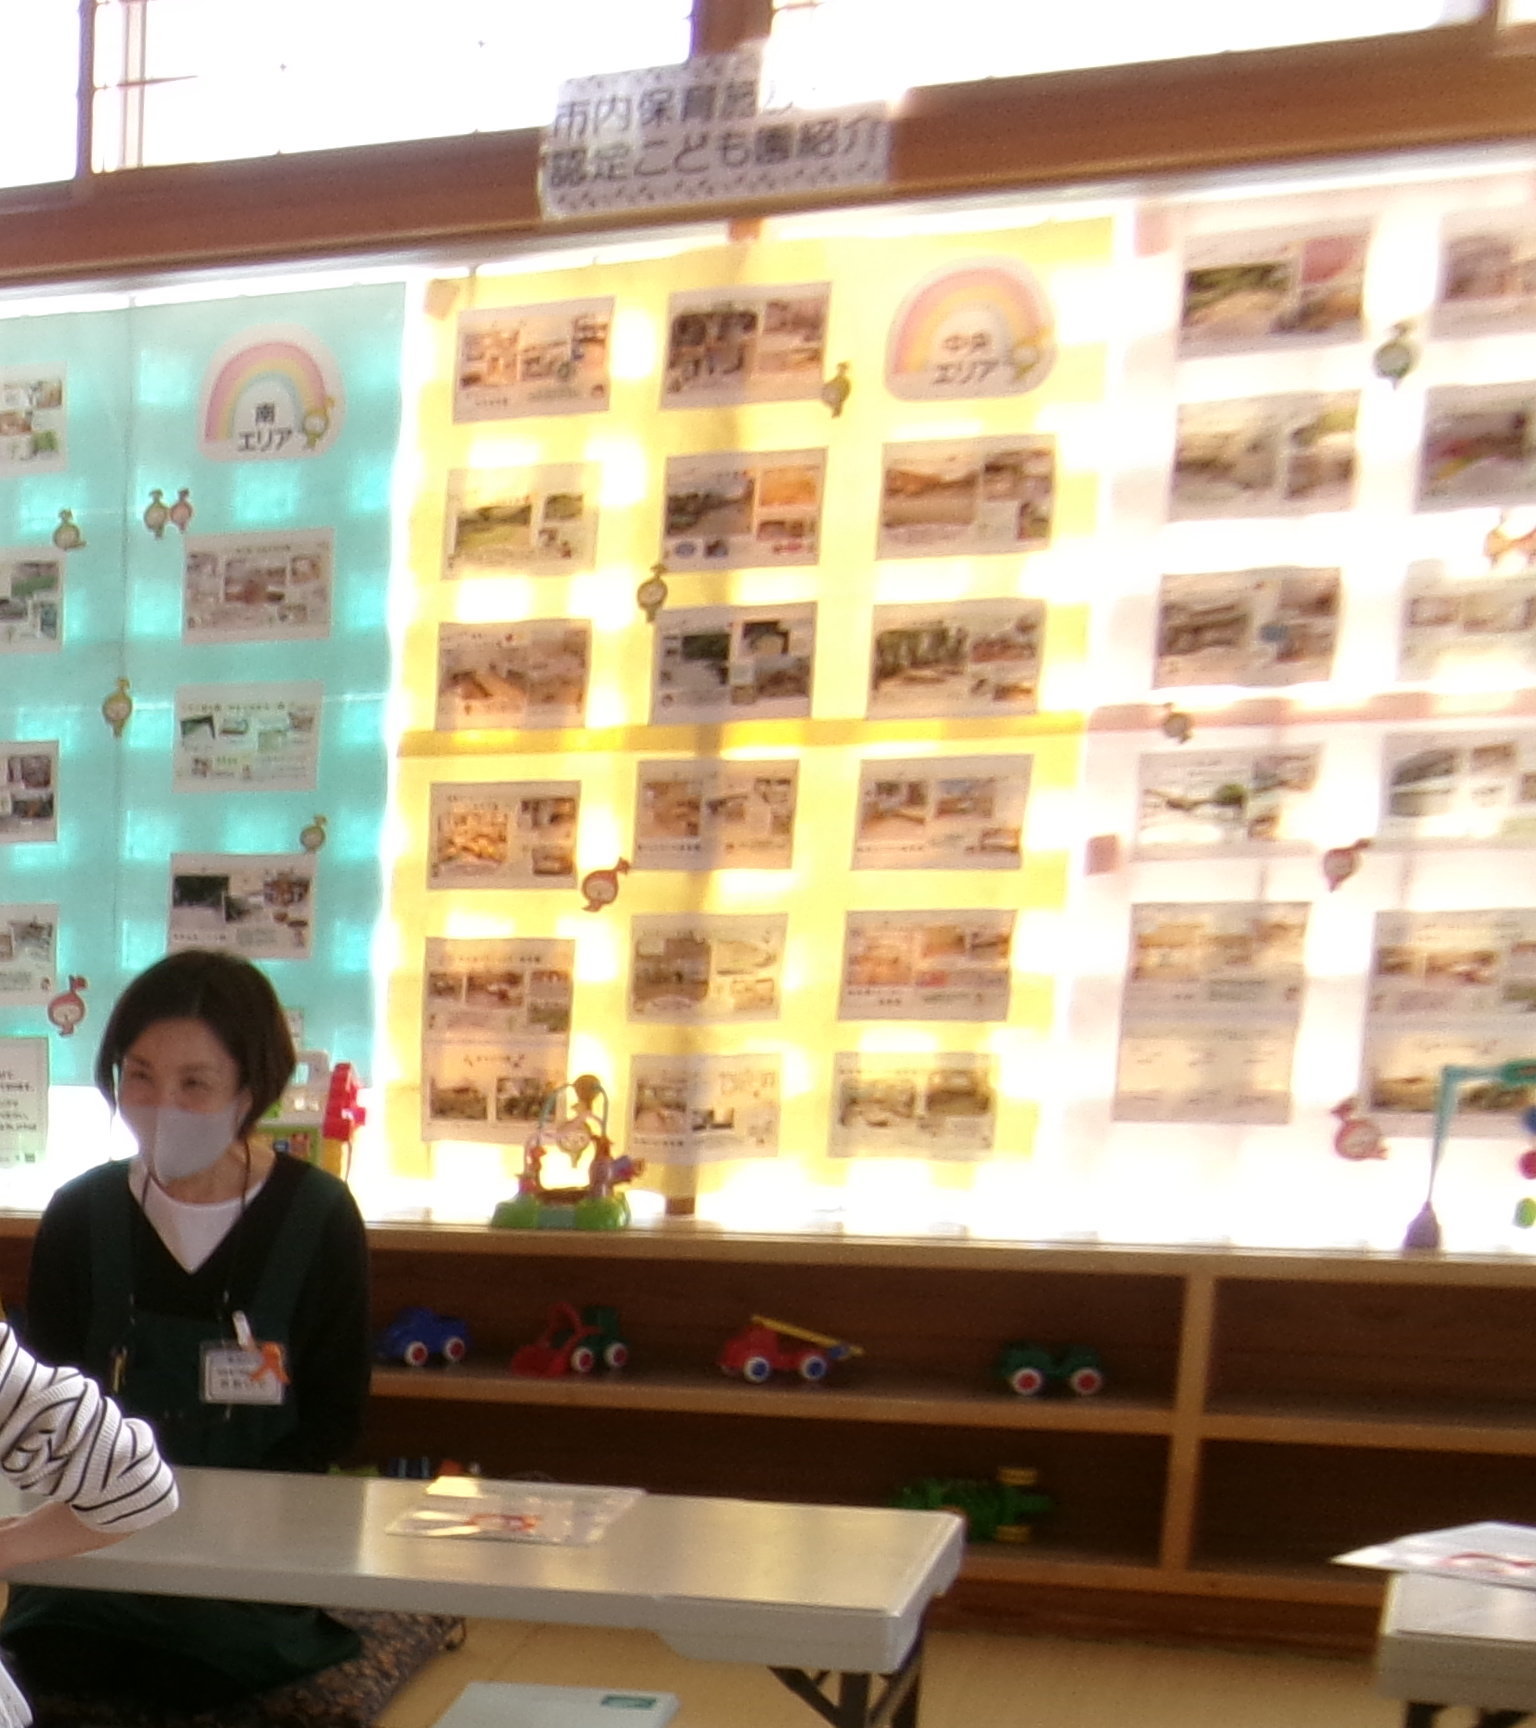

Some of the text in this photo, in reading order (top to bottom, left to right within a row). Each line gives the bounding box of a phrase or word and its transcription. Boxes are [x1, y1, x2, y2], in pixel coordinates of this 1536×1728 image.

[548, 115, 891, 188] 認定こども園紹介
[932, 359, 1000, 385] エリア
[255, 402, 275, 425] 南
[237, 427, 292, 453] エリア
